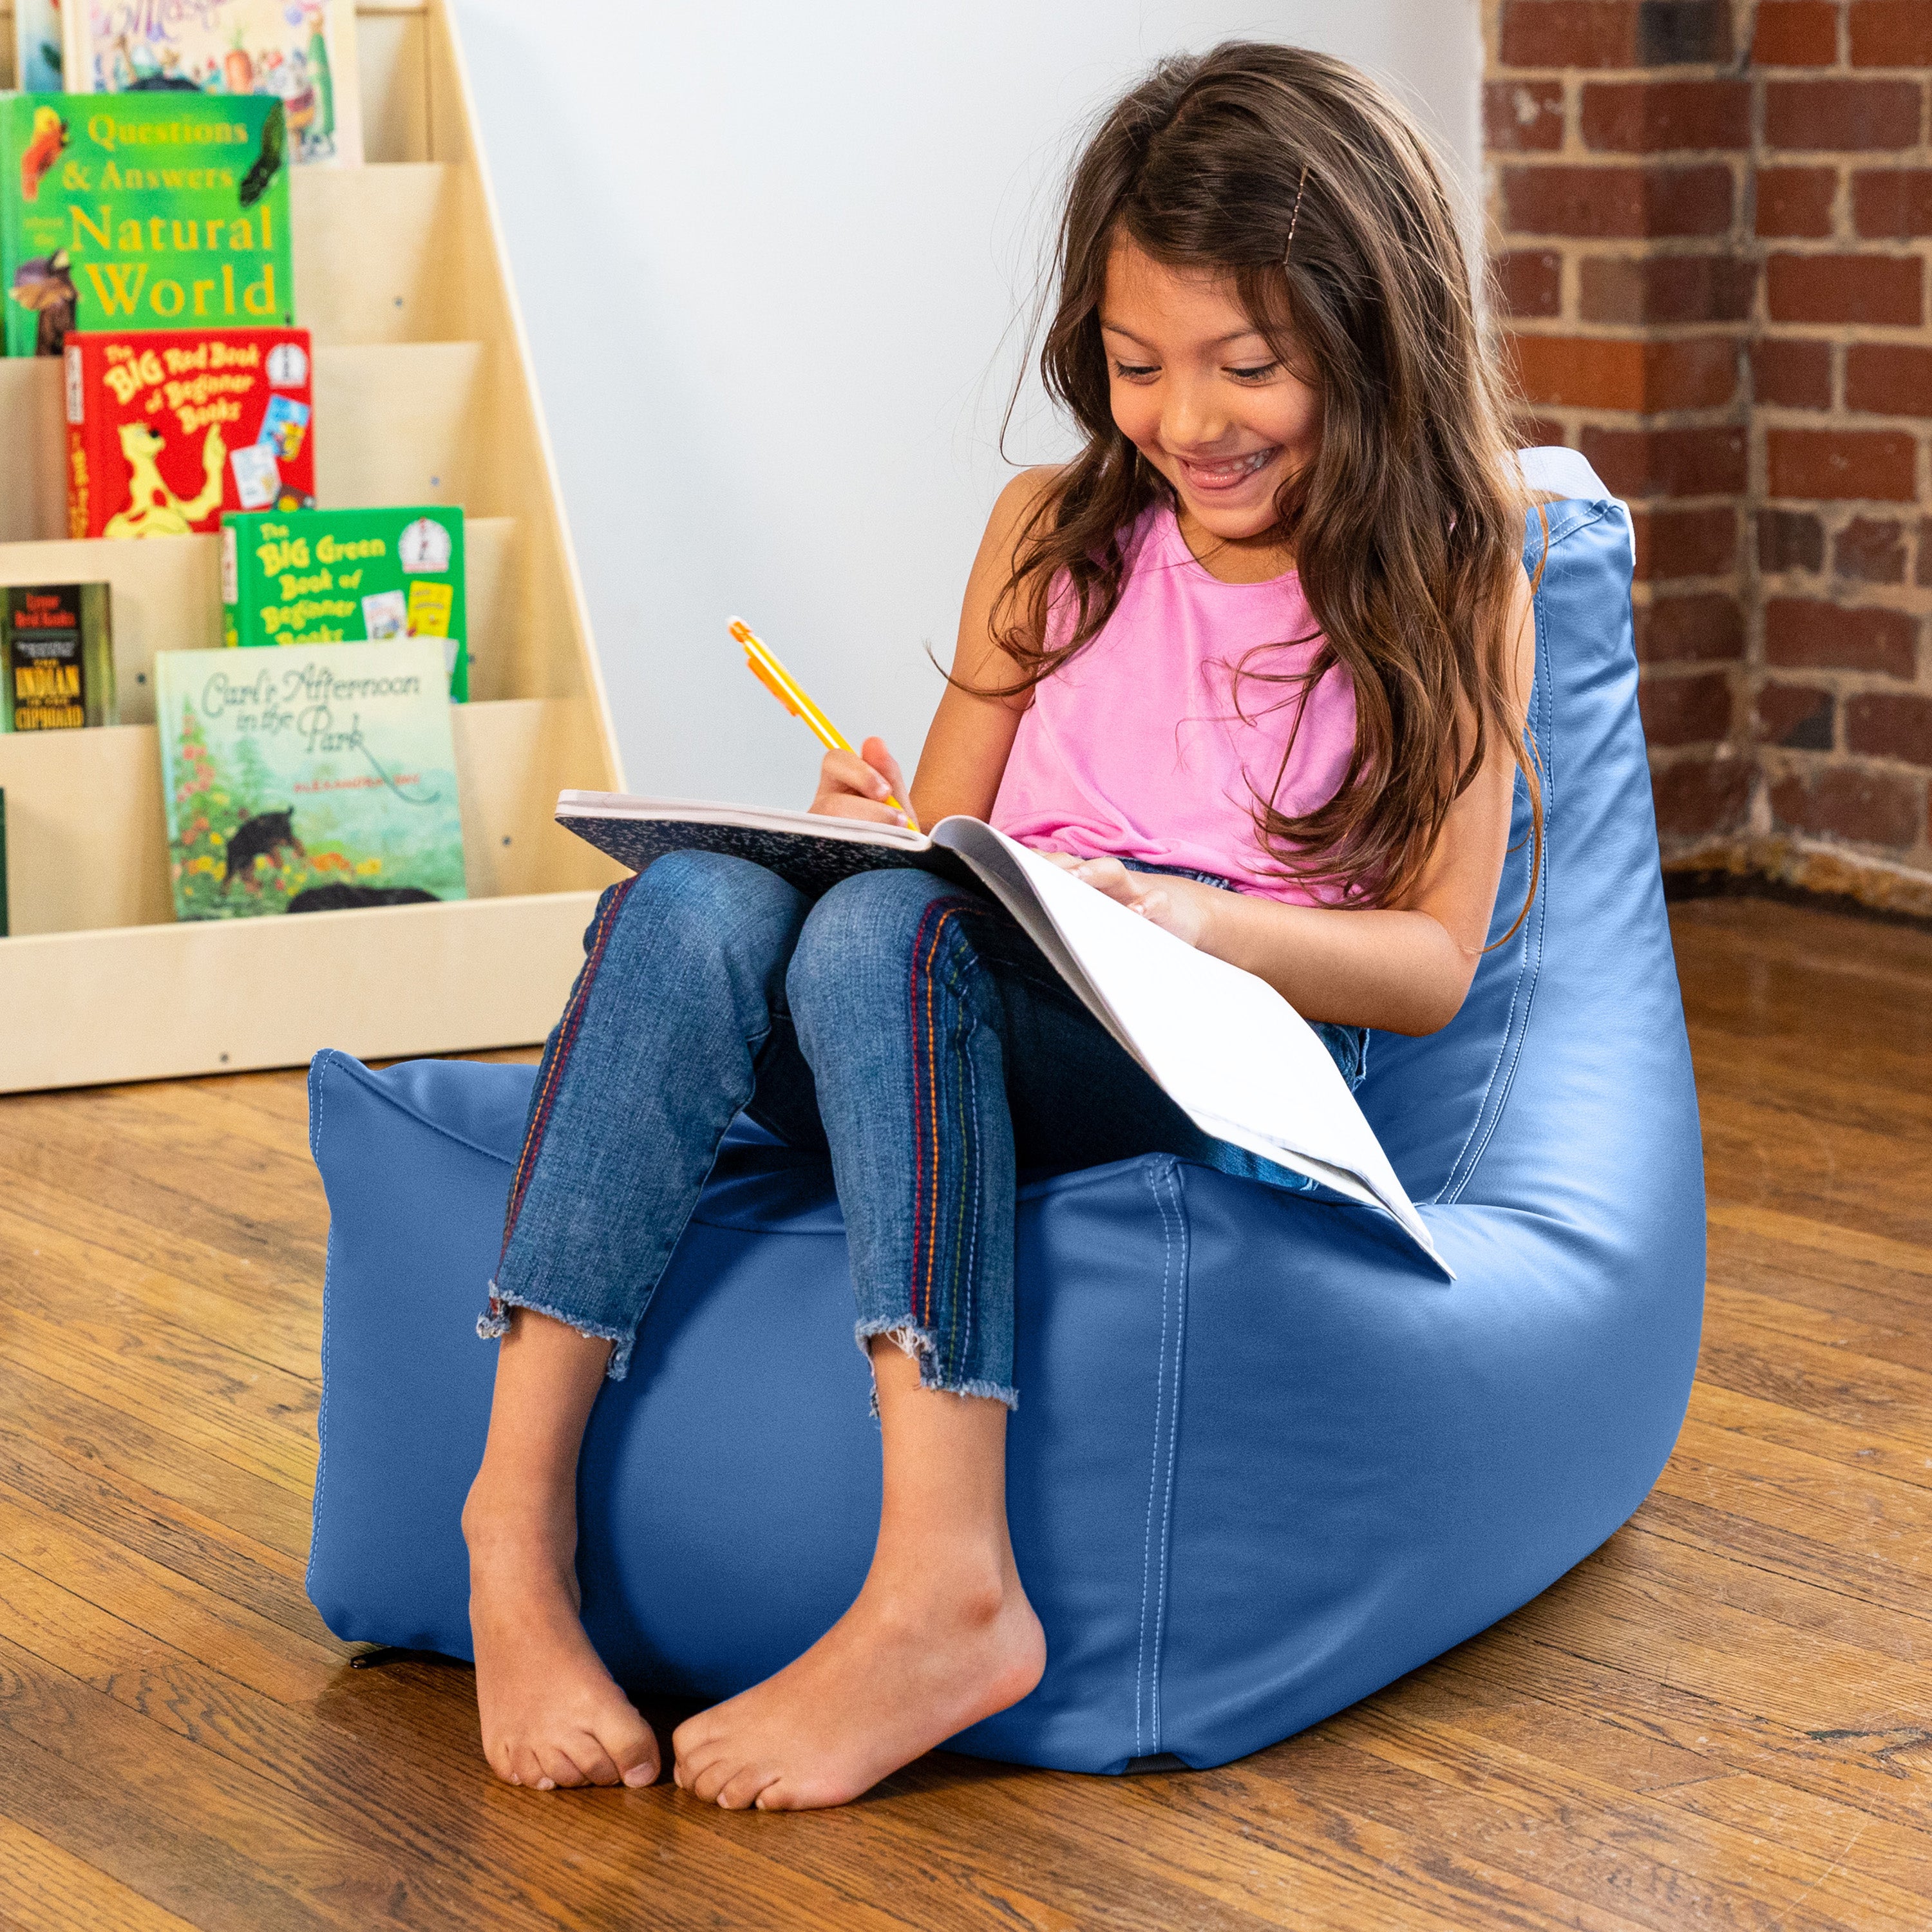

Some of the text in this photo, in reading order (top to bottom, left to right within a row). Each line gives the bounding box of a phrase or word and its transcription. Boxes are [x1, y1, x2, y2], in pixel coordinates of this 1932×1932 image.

[88, 113, 249, 152] Questions
[62, 160, 233, 191] & Answers
[69, 205, 274, 252] Natural
[85, 263, 276, 316] World
[103, 348, 166, 405] BIG
[163, 342, 208, 374] Red
[210, 341, 259, 368] Book
[104, 345, 134, 365] The
[164, 374, 255, 410] Beginner
[176, 397, 242, 435] Books
[260, 522, 289, 541] The
[256, 537, 310, 578] BIG
[316, 535, 386, 564] Green
[278, 567, 363, 601] Book of
[260, 600, 357, 634] Beginner
[15, 666, 79, 699] INDIAN
[282, 661, 422, 706] Afternoon
[236, 708, 257, 732] in
[297, 705, 365, 754] Park
